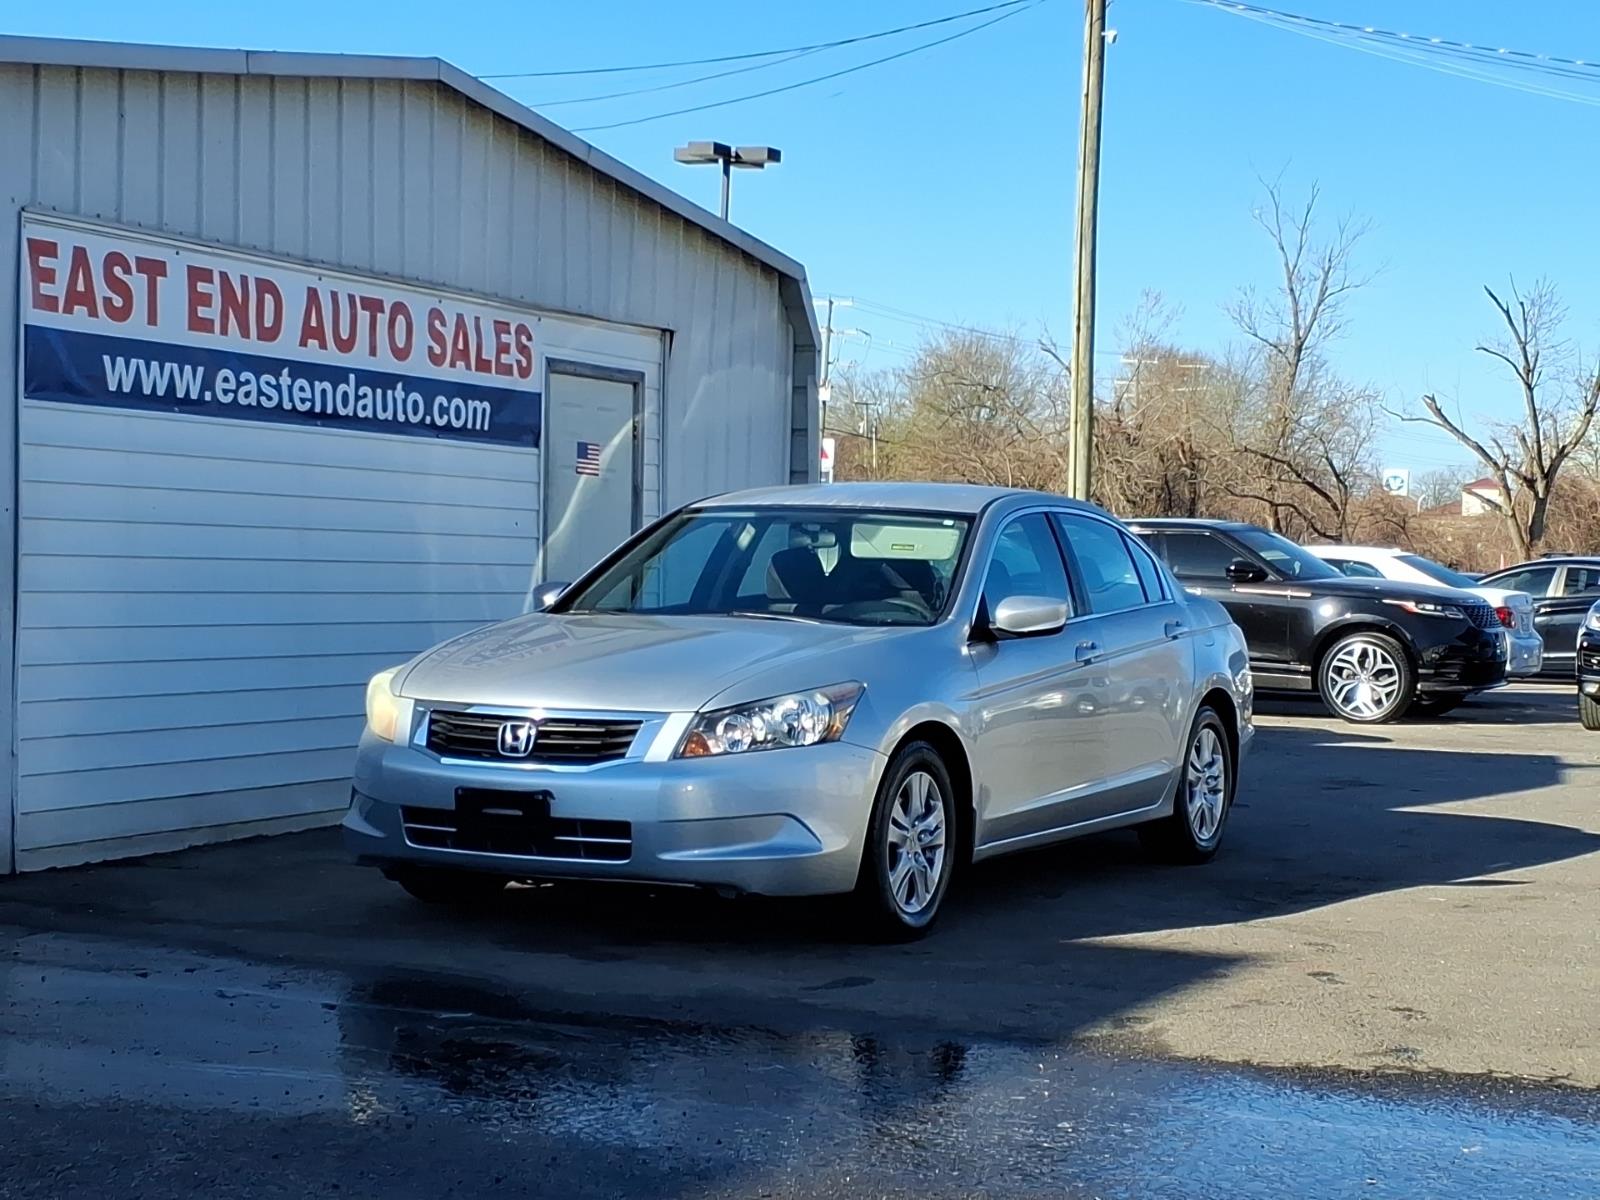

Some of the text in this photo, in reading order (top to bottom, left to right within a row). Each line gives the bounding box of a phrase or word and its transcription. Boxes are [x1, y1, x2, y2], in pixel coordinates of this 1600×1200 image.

[27, 237, 534, 380] EAST END AUTO SALES
[102, 354, 492, 431] www.eastendauto.com
